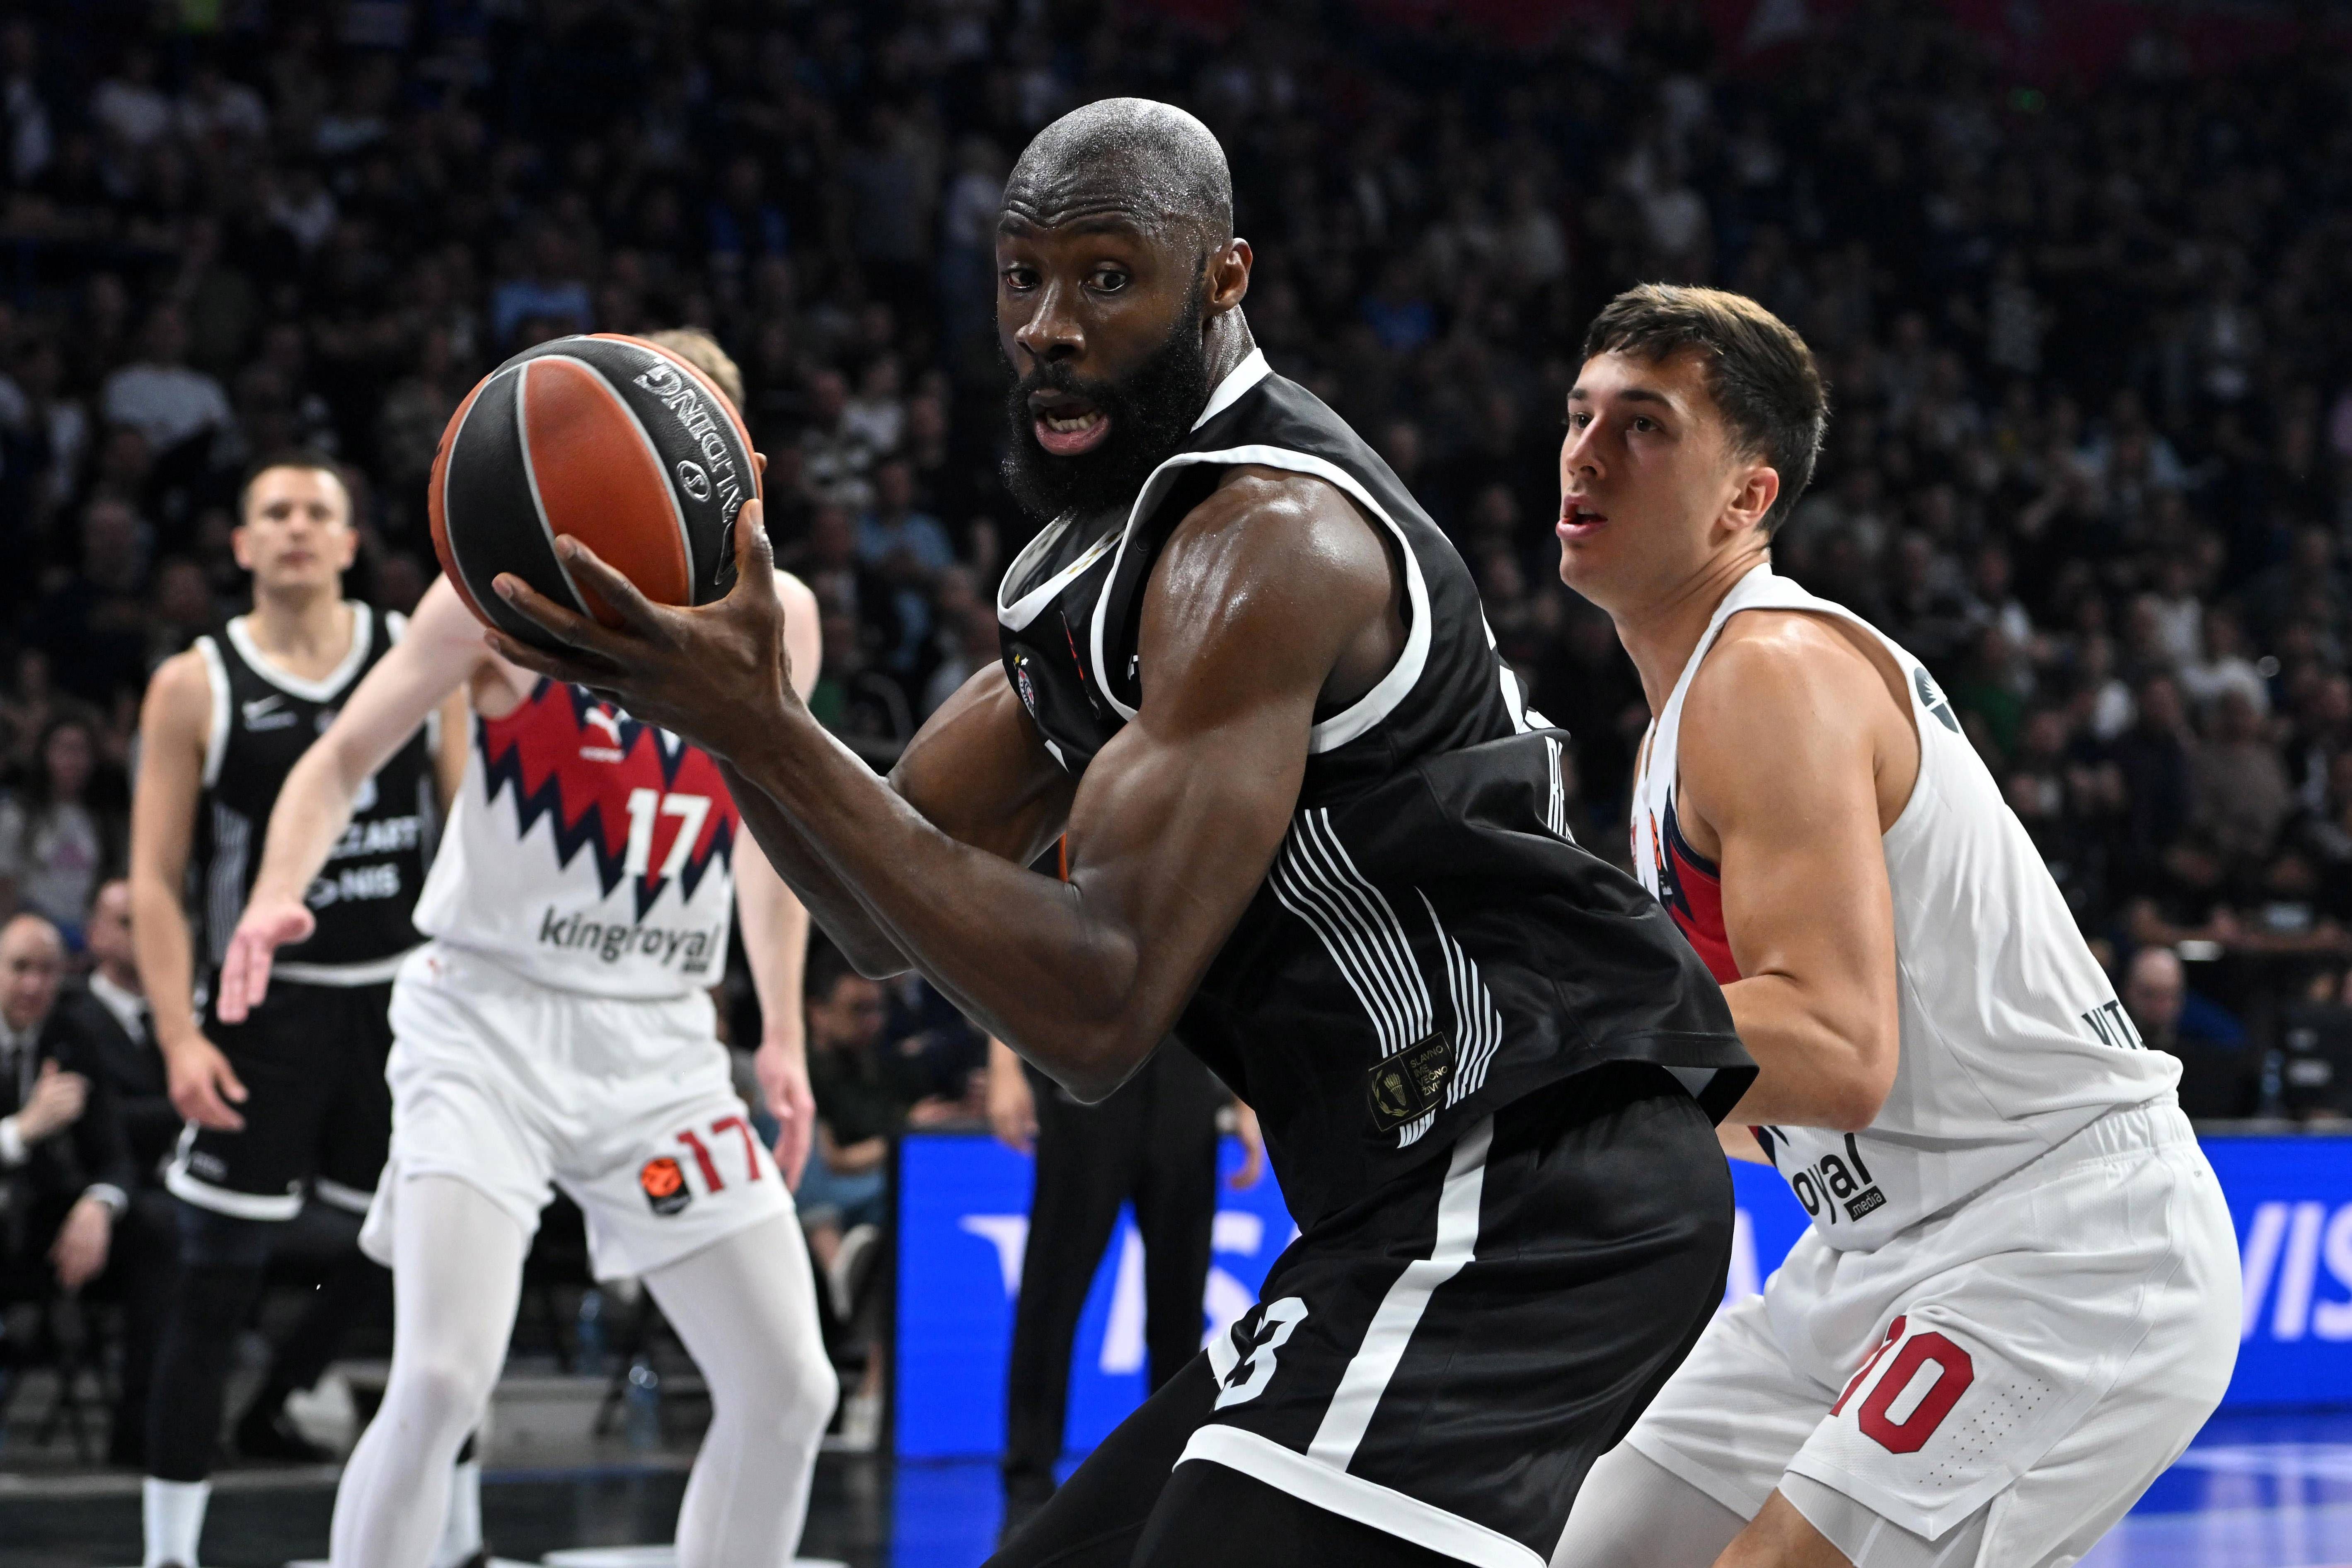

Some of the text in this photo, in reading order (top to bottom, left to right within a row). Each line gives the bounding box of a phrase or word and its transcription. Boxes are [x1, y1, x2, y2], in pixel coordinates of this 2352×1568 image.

[625, 787, 712, 877] 17
[2081, 999, 2145, 1049] VIT
[1410, 1045, 1443, 1068] SLAVNO
[675, 1116, 760, 1192] 17
